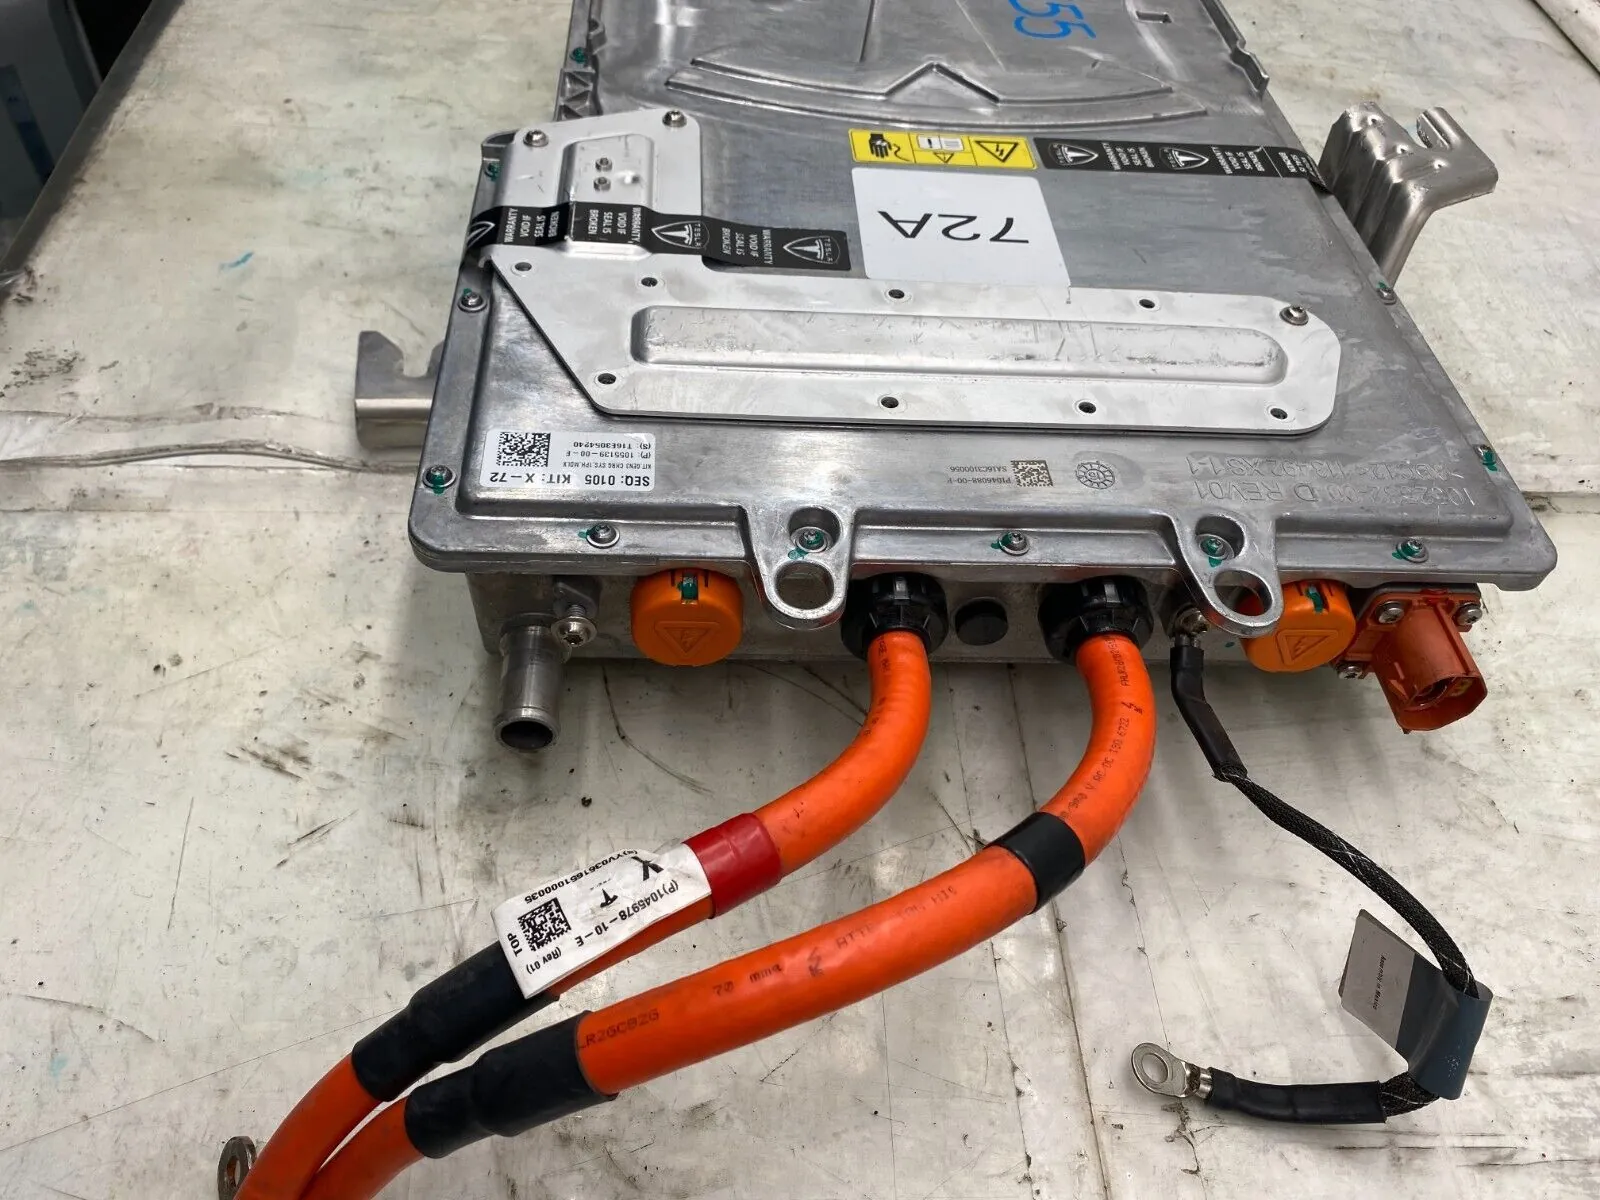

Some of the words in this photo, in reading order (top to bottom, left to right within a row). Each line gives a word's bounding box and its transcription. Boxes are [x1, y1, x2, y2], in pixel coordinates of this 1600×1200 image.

[504, 208, 518, 243] WARRANTY
[548, 211, 560, 238] BROKEN
[588, 209, 599, 234] BROKEN
[604, 212, 613, 227] SEAL
[618, 212, 628, 228] VOID
[631, 207, 642, 243] WARRANTY
[877, 211, 1029, 243] 72A
[520, 223, 530, 238] VOID
[534, 223, 545, 238] SEAL
[721, 227, 731, 255] BROKEN
[735, 232, 744, 248] SEAL
[749, 234, 758, 250] VOID
[762, 229, 774, 265] WARRANTY
[573, 442, 632, 450] T16E3054240
[541, 474, 571, 484] KIT:
[584, 474, 616, 486] 0105
[620, 475, 650, 486] SEQ:
[1294, 483, 1319, 501] D
[507, 933, 523, 957] TOP
[542, 946, 562, 966] (Rev
[526, 960, 541, 975] 01)
